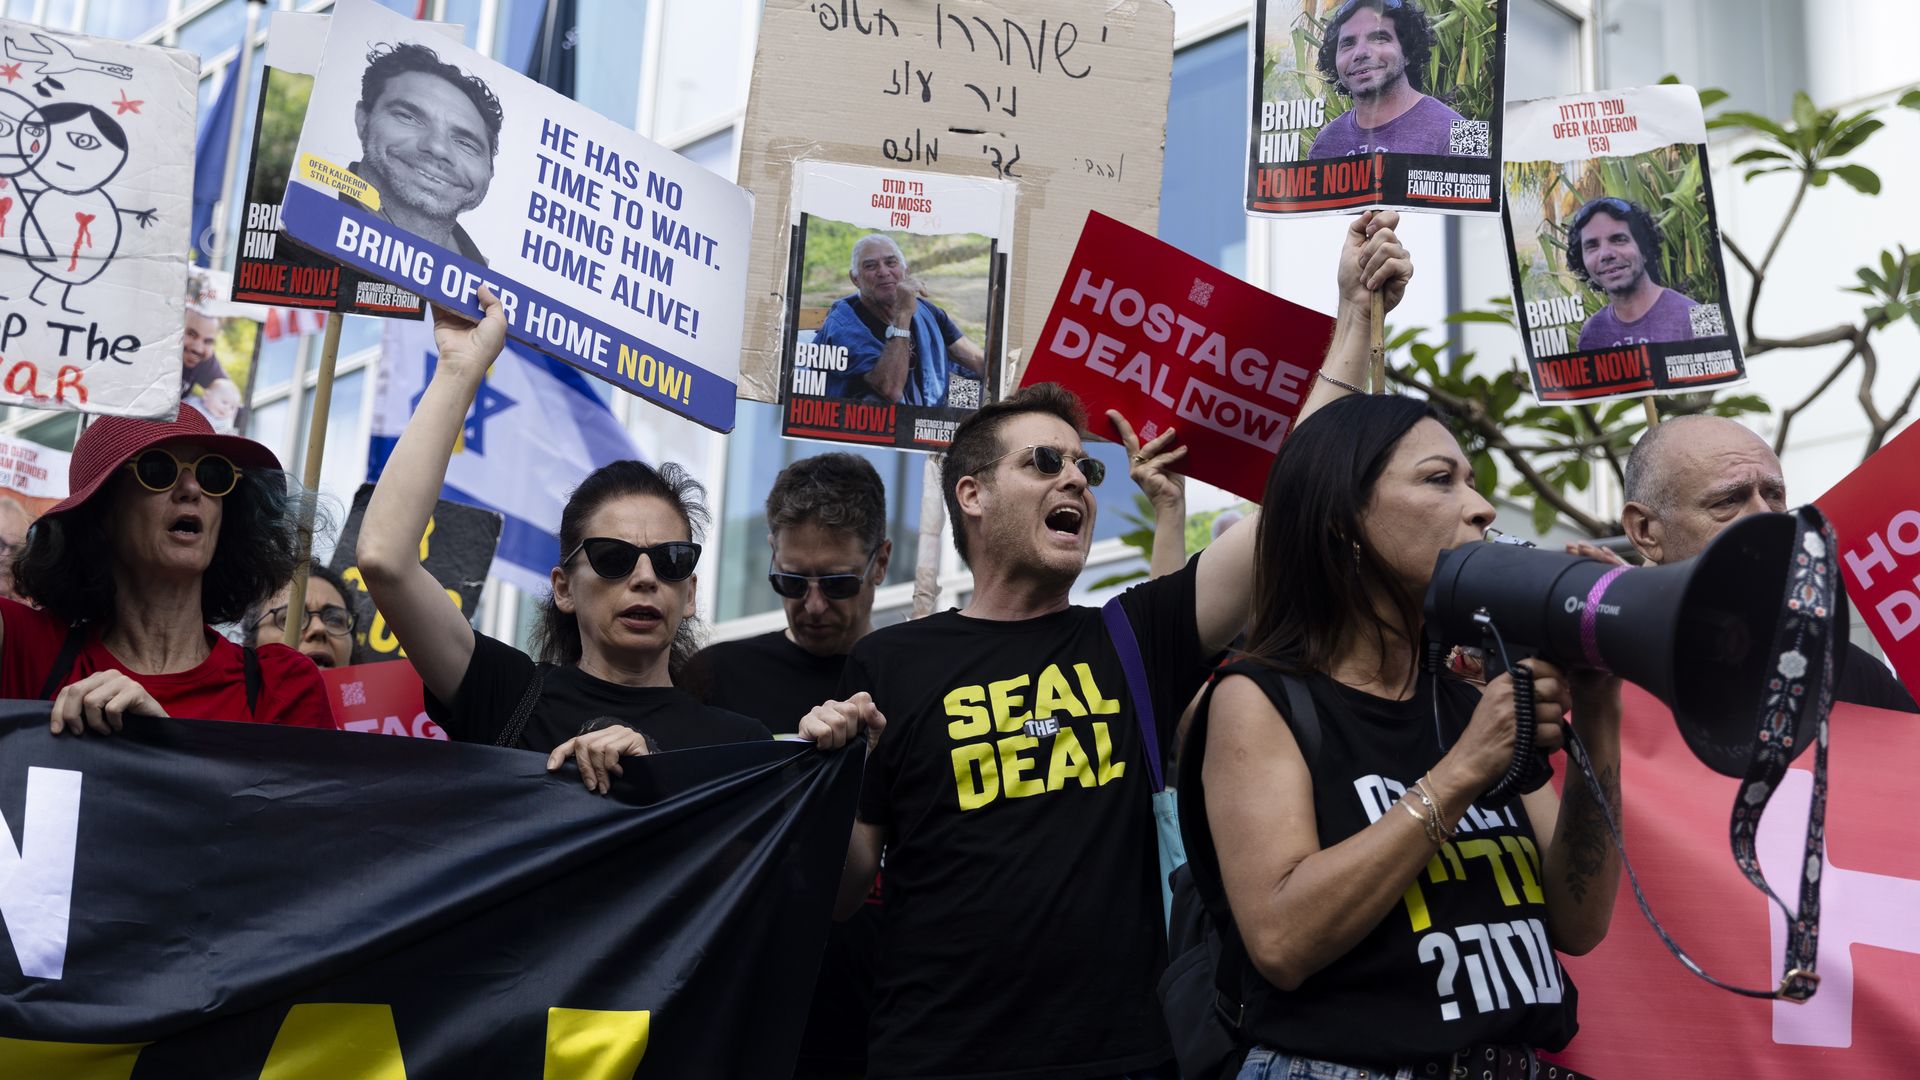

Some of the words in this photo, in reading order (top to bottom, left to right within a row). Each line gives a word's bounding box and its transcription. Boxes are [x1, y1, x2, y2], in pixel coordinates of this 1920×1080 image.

[883, 60, 933, 103] עוז
[964, 83, 1017, 117] ניר
[1260, 97, 1326, 132] BRING
[1560, 102, 1596, 121] קלדרון
[1598, 99, 1624, 116] עופר
[1552, 121, 1580, 139] OFER
[1582, 115, 1637, 136] KALDERON
[882, 128, 938, 166] מוזס
[1258, 131, 1300, 163] HIM
[1587, 135, 1611, 154] (53)
[309, 159, 328, 173] OFER
[329, 168, 368, 191] KALDERON
[540, 118, 579, 160] HE
[584, 140, 640, 189] HAS
[646, 170, 683, 211] NO
[983, 144, 1022, 180] גדי
[1256, 165, 1317, 198] HOME
[1323, 153, 1384, 195] NOW!
[1408, 169, 1443, 182] HOSTAGES
[1444, 171, 1459, 184] AND
[1459, 173, 1490, 185] MISSING
[310, 170, 330, 185] STILL
[331, 179, 363, 199] CAPTIVE
[882, 178, 905, 194] מוזס
[909, 181, 923, 196] גדי
[1408, 179, 1452, 198] FAMILIES
[1454, 183, 1490, 200] FORUM
[246, 203, 282, 231] BRI
[536, 153, 603, 212] TIME
[610, 190, 644, 230] TO
[652, 210, 720, 271] WAIT.
[871, 193, 896, 210] GADI
[897, 196, 932, 213] MOSES
[890, 211, 911, 229] (79)
[243, 231, 277, 260] HIM
[527, 191, 615, 256] BRING
[620, 236, 675, 287] HIM
[239, 261, 288, 293] HOME
[289, 266, 342, 297] NOW!
[357, 280, 385, 293] HOSTAGES
[385, 283, 397, 294] AND
[520, 229, 606, 295] HOME
[610, 273, 700, 340] ALIVE!
[336, 216, 435, 286] BRING
[524, 301, 611, 367] HOME
[616, 343, 692, 405] NOW!
[355, 290, 391, 306] FAMILIES
[391, 293, 420, 309] FORUM
[1524, 293, 1585, 329] BRING
[46, 320, 142, 365] The
[1069, 268, 1309, 405] HOSTAGE
[1529, 325, 1569, 358] HIM
[794, 342, 849, 372] BRING
[1536, 356, 1592, 389] HOME
[1594, 344, 1652, 383] NOW!
[1667, 361, 1705, 379] FAMILIES
[1704, 358, 1736, 376] FORUM
[792, 368, 828, 397] HIM
[1049, 317, 1176, 409] DEAL
[1185, 386, 1282, 443] NOW
[789, 398, 841, 428] HOME
[844, 403, 896, 434] NOW!
[914, 427, 950, 442] FAMILIES
[943, 662, 1120, 740] SEAL
[1027, 717, 1057, 737] THE
[951, 721, 1126, 811] DEAL
[1417, 918, 1565, 1022] עזה?
